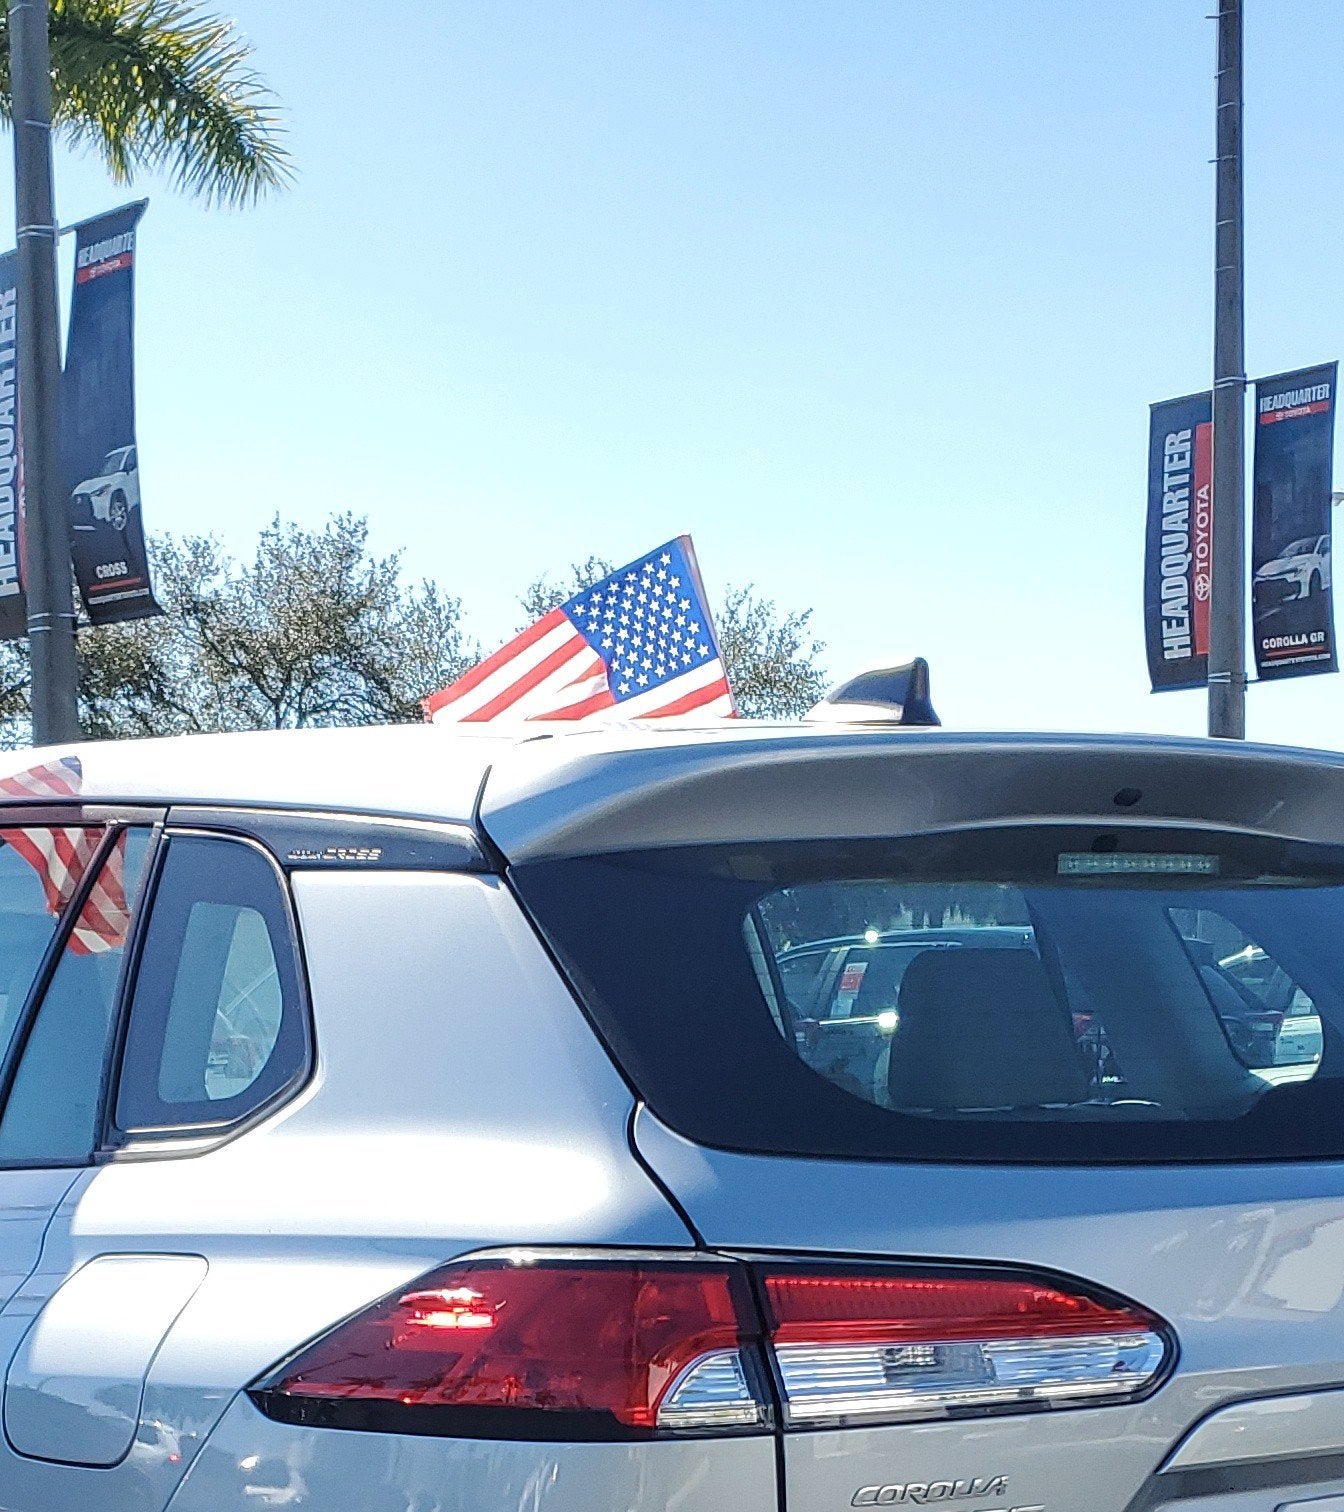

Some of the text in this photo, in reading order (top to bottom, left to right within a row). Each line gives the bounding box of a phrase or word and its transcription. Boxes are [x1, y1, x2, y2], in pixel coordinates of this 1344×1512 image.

[1259, 383, 1330, 413] HEADQUARTER
[1160, 428, 1192, 660] HEADQUARTER
[1194, 484, 1210, 573] TOYOTA
[96, 561, 128, 579] CROSS
[1262, 633, 1309, 649] COROLLA
[850, 1474, 1010, 1507] COROLLA
